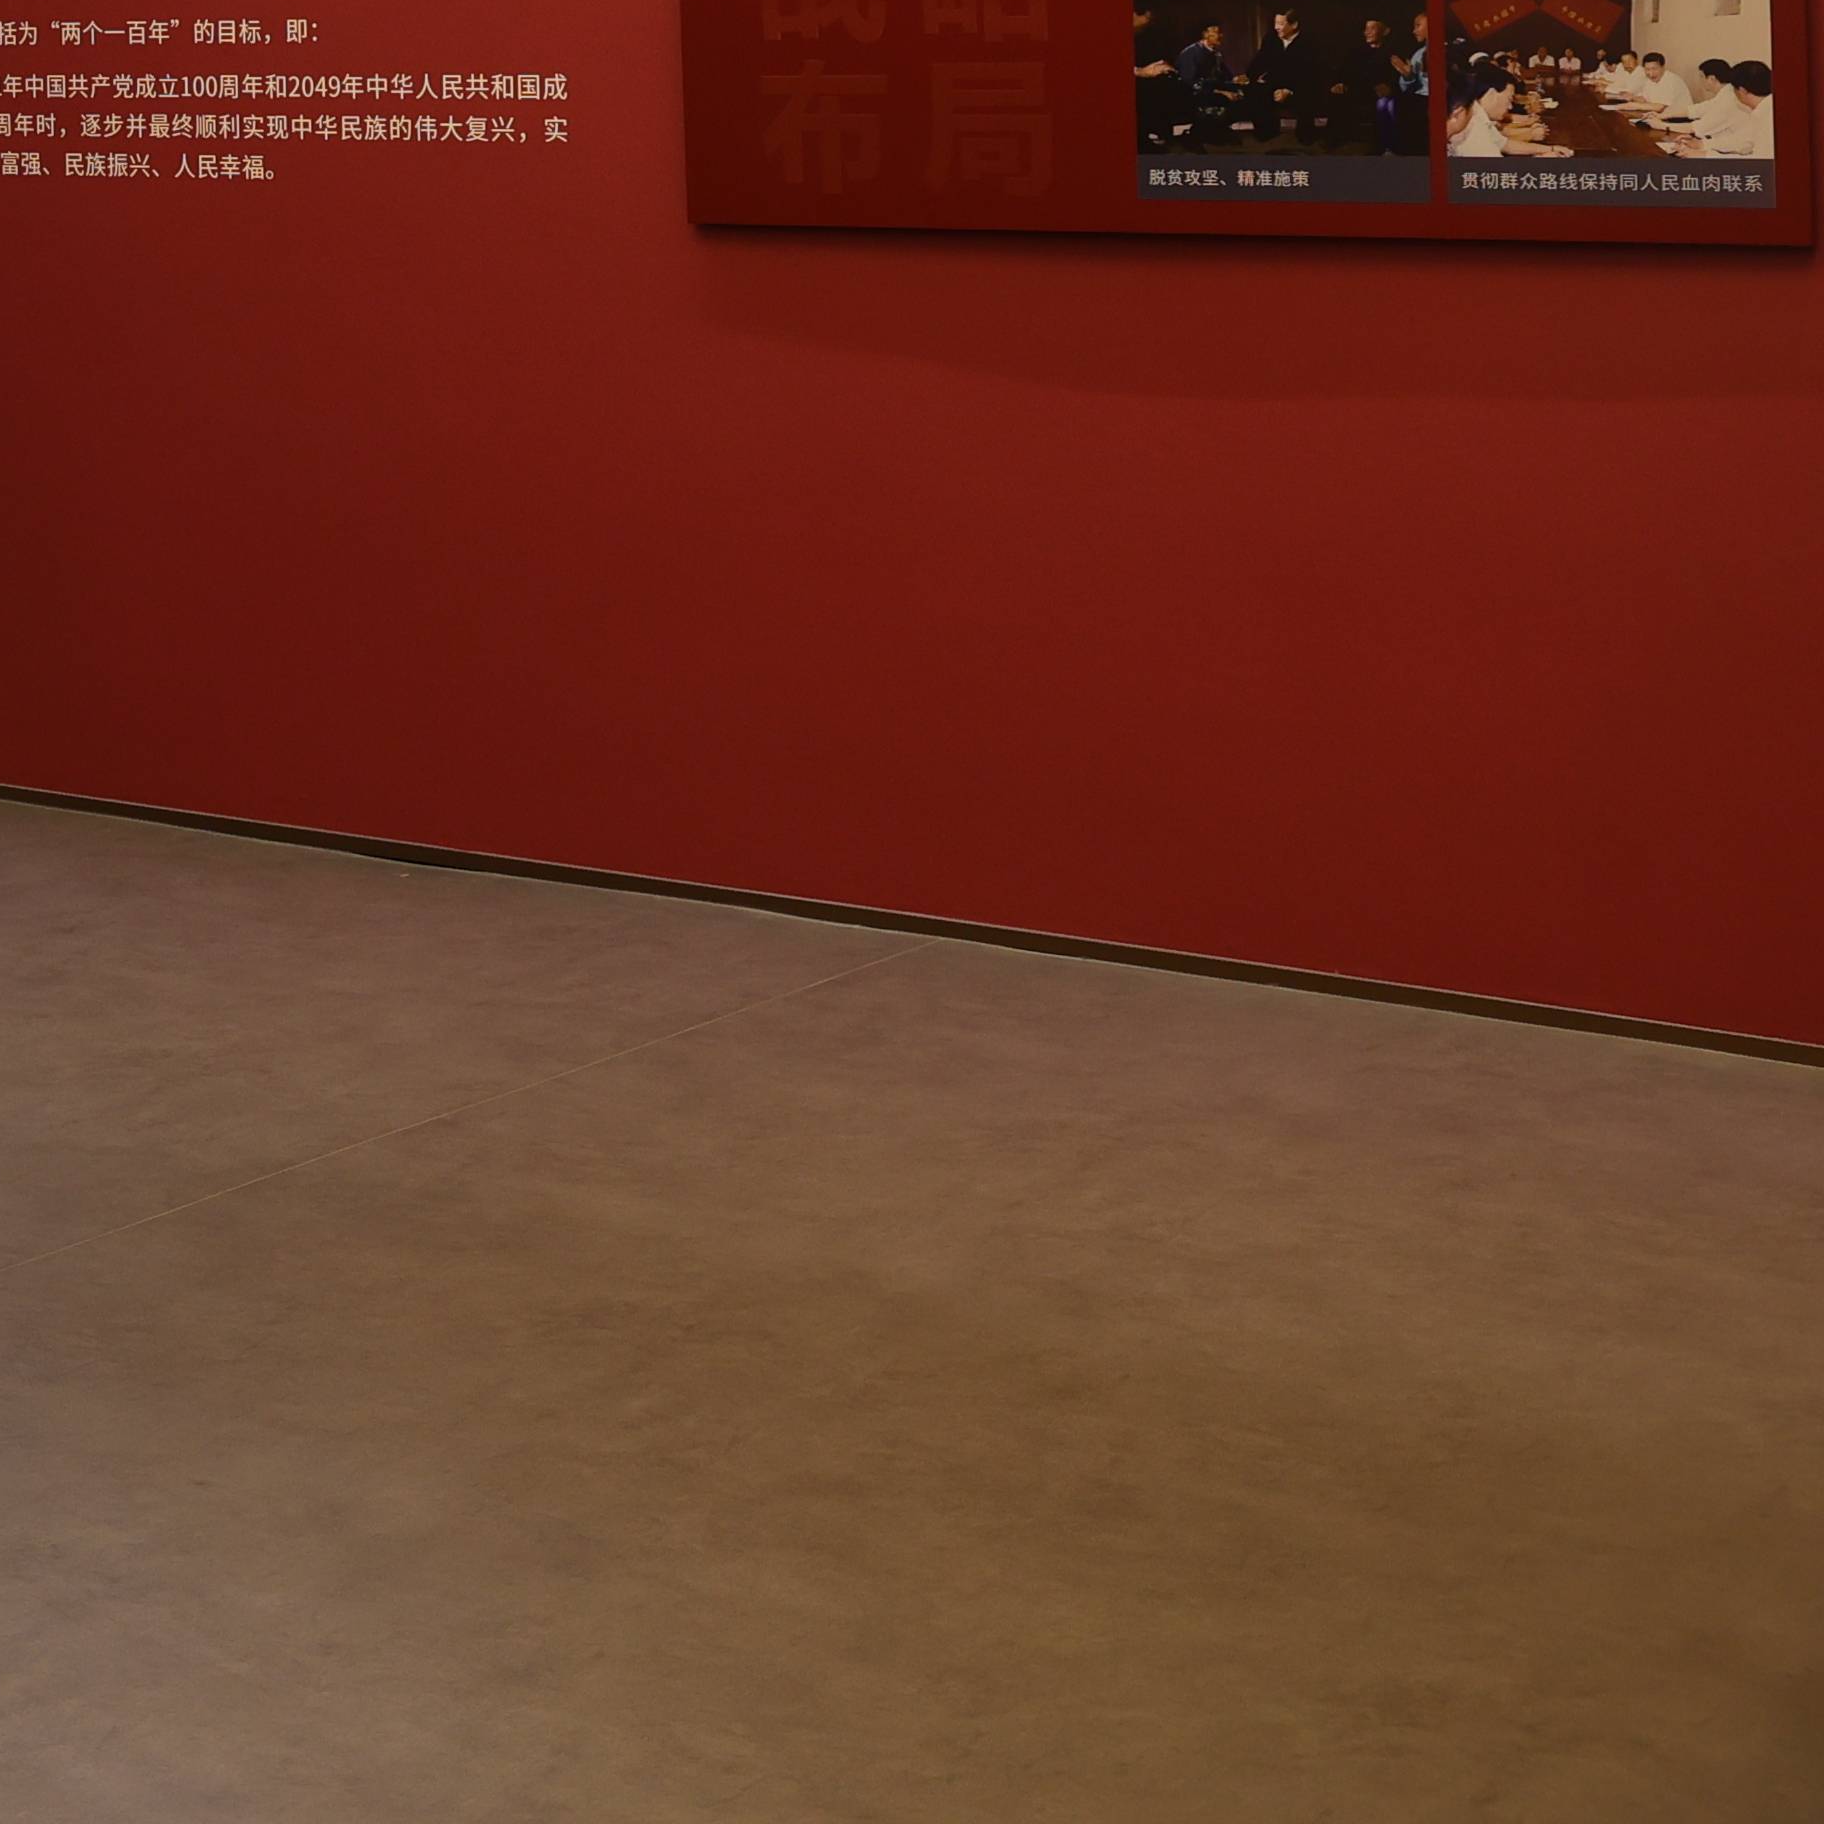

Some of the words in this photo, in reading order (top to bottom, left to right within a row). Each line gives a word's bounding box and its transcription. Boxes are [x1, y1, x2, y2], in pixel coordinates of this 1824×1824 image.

[1148, 168, 1310, 188] 脱贫攻坚、精准施策
[1460, 171, 1764, 193] 贯彻群众路线保持同人民血肉联系
